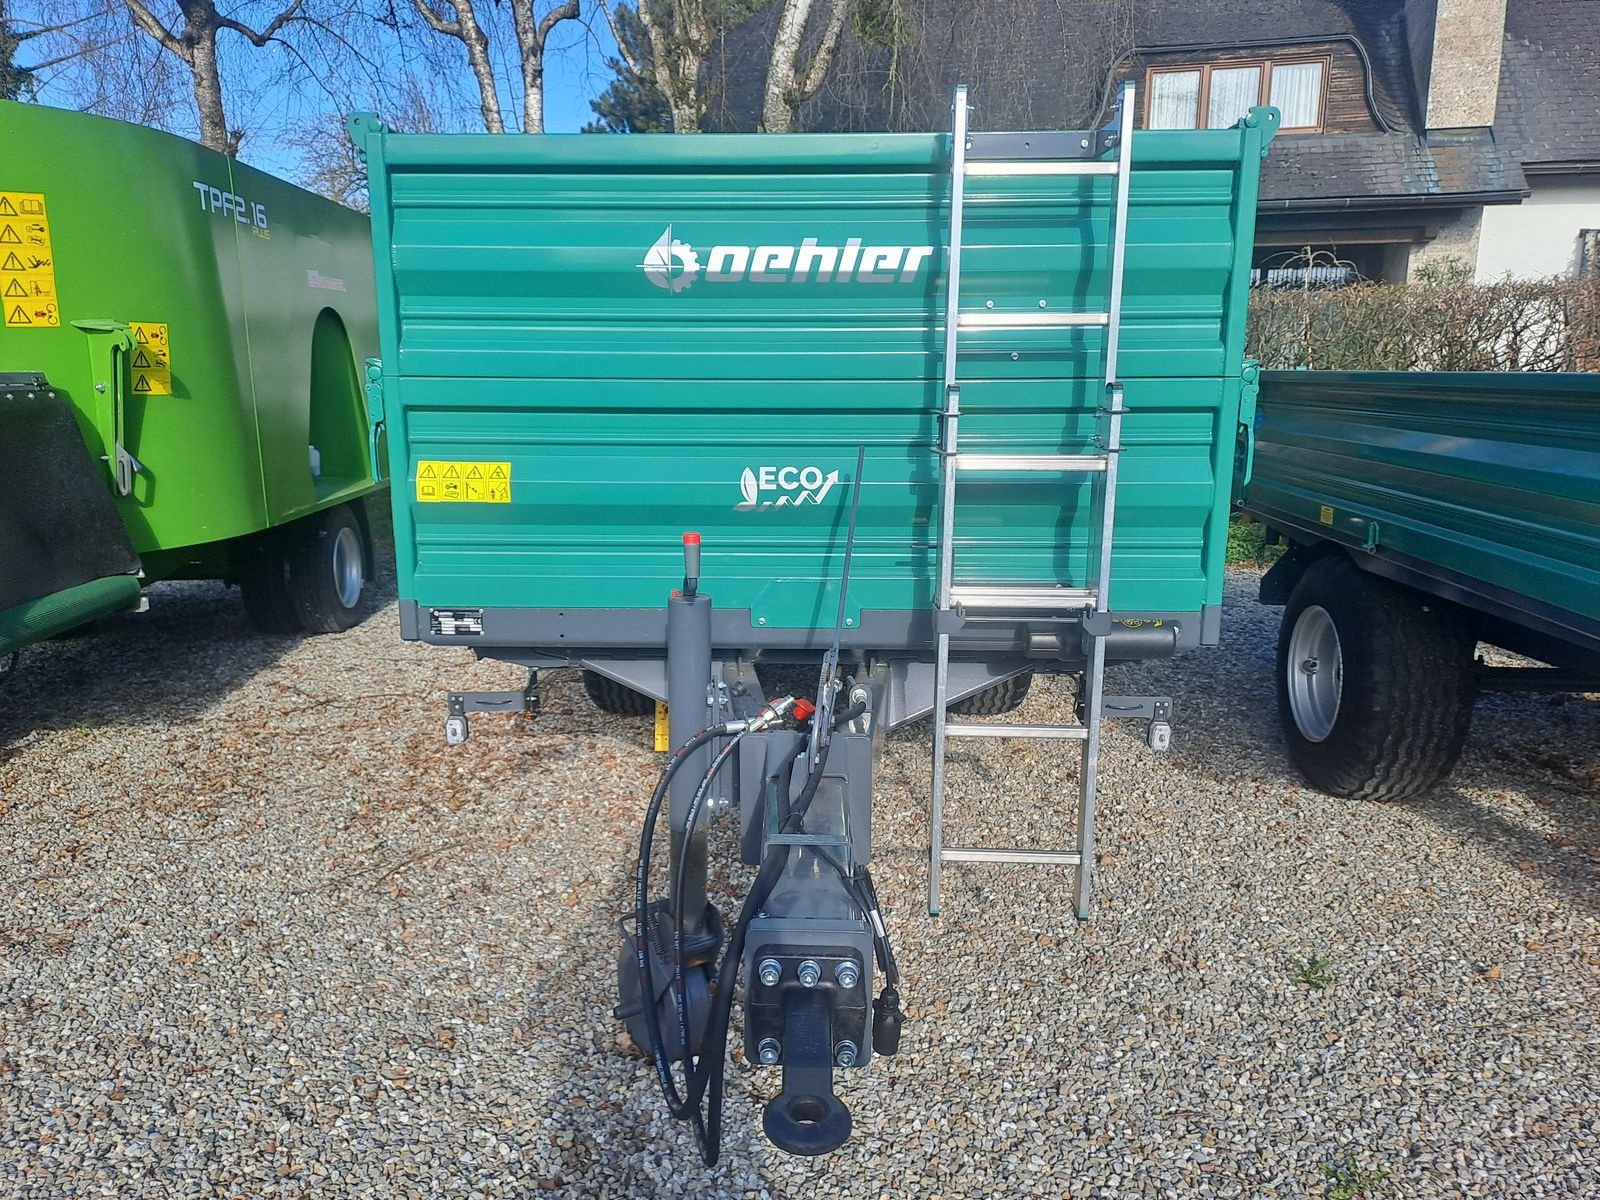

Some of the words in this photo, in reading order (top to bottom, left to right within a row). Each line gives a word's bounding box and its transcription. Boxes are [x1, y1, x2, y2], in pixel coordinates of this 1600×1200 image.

[192, 181, 267, 229] TPF2.16
[251, 225, 271, 240] PLUS
[704, 237, 935, 284] oehler
[759, 466, 823, 490] ECO
